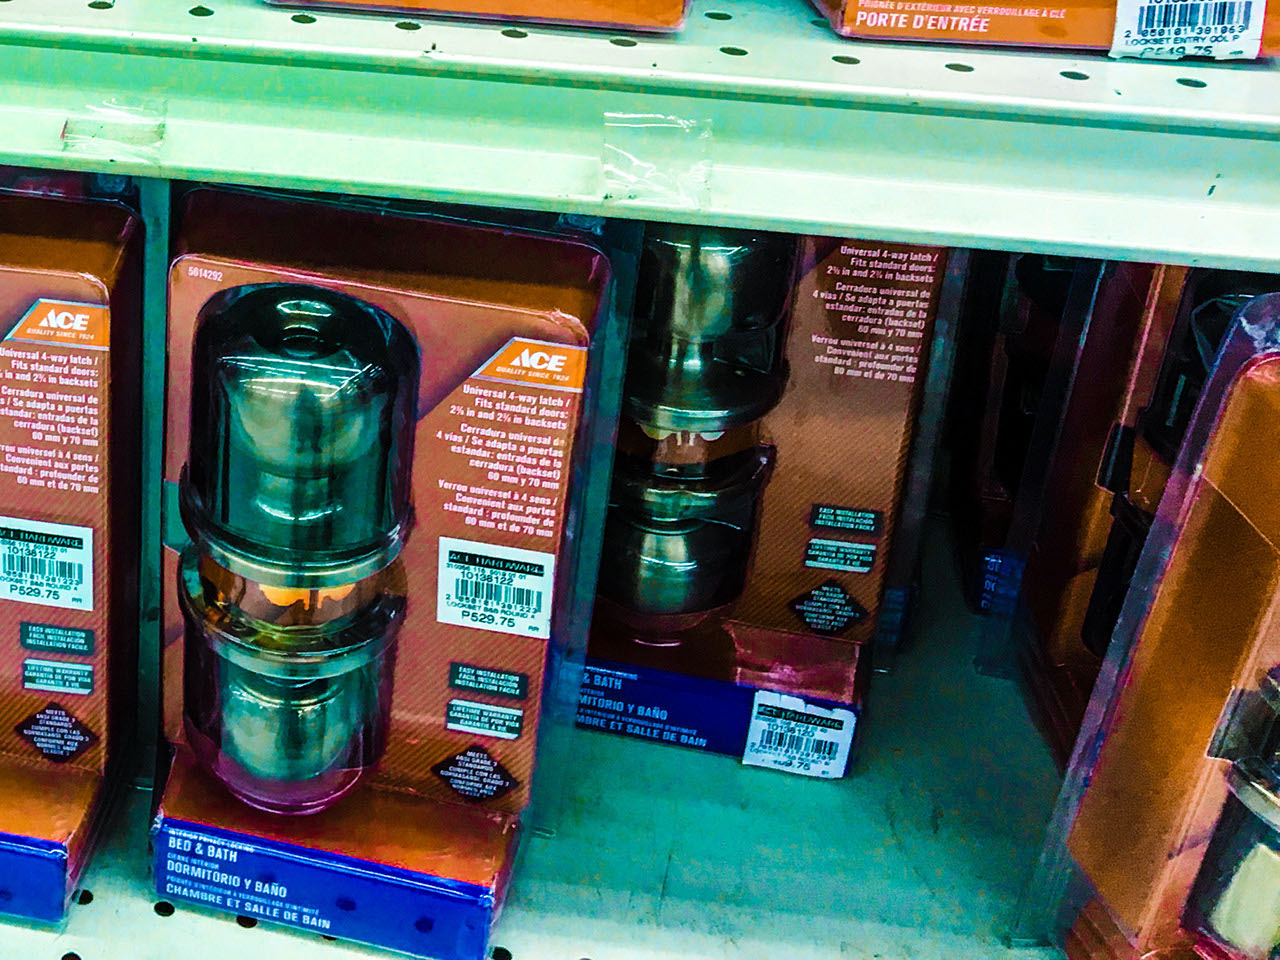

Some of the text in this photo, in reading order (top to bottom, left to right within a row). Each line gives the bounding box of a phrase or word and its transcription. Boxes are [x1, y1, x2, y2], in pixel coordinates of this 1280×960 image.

[856, 13, 990, 32] PORTE D'ENTRÉE
[38, 309, 90, 331] ACE
[509, 347, 567, 372] ACE
[7, 547, 56, 559] 10138122
[461, 571, 513, 586] 10138122
[10, 585, 60, 600] P529.75
[462, 610, 515, 628] P529.75
[169, 837, 238, 862] BED & BATH
[167, 860, 288, 898] DORMITORIO Y BAÑO
[166, 884, 331, 929] CHAMBRE ET SALLE DE BAIN
